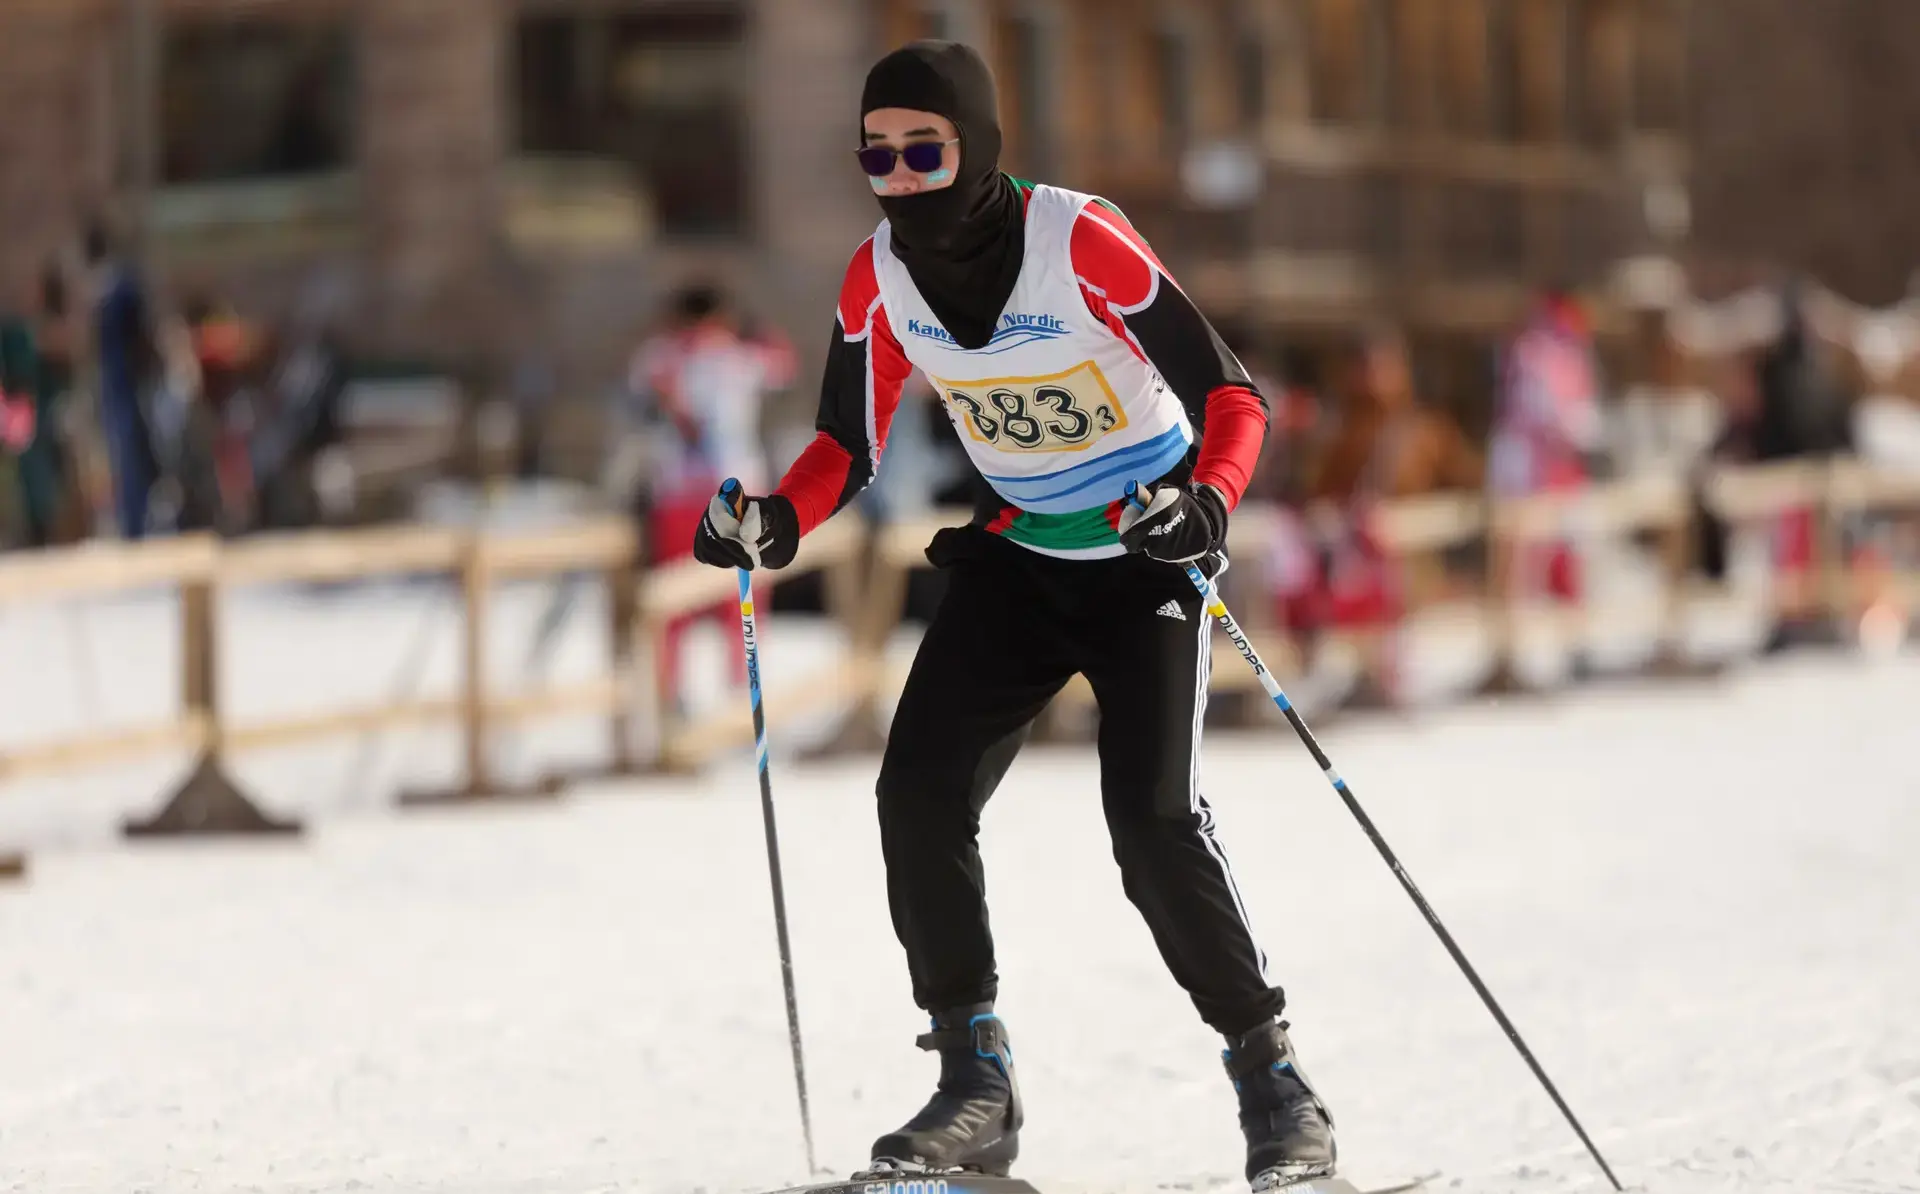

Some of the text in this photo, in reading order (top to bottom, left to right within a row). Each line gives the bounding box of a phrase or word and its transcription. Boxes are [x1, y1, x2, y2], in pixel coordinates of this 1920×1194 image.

[1002, 312, 1065, 331] Nordic
[1095, 404, 1117, 433] 3
[1156, 609, 1187, 621] adidas
[1218, 614, 1265, 676] salomo
